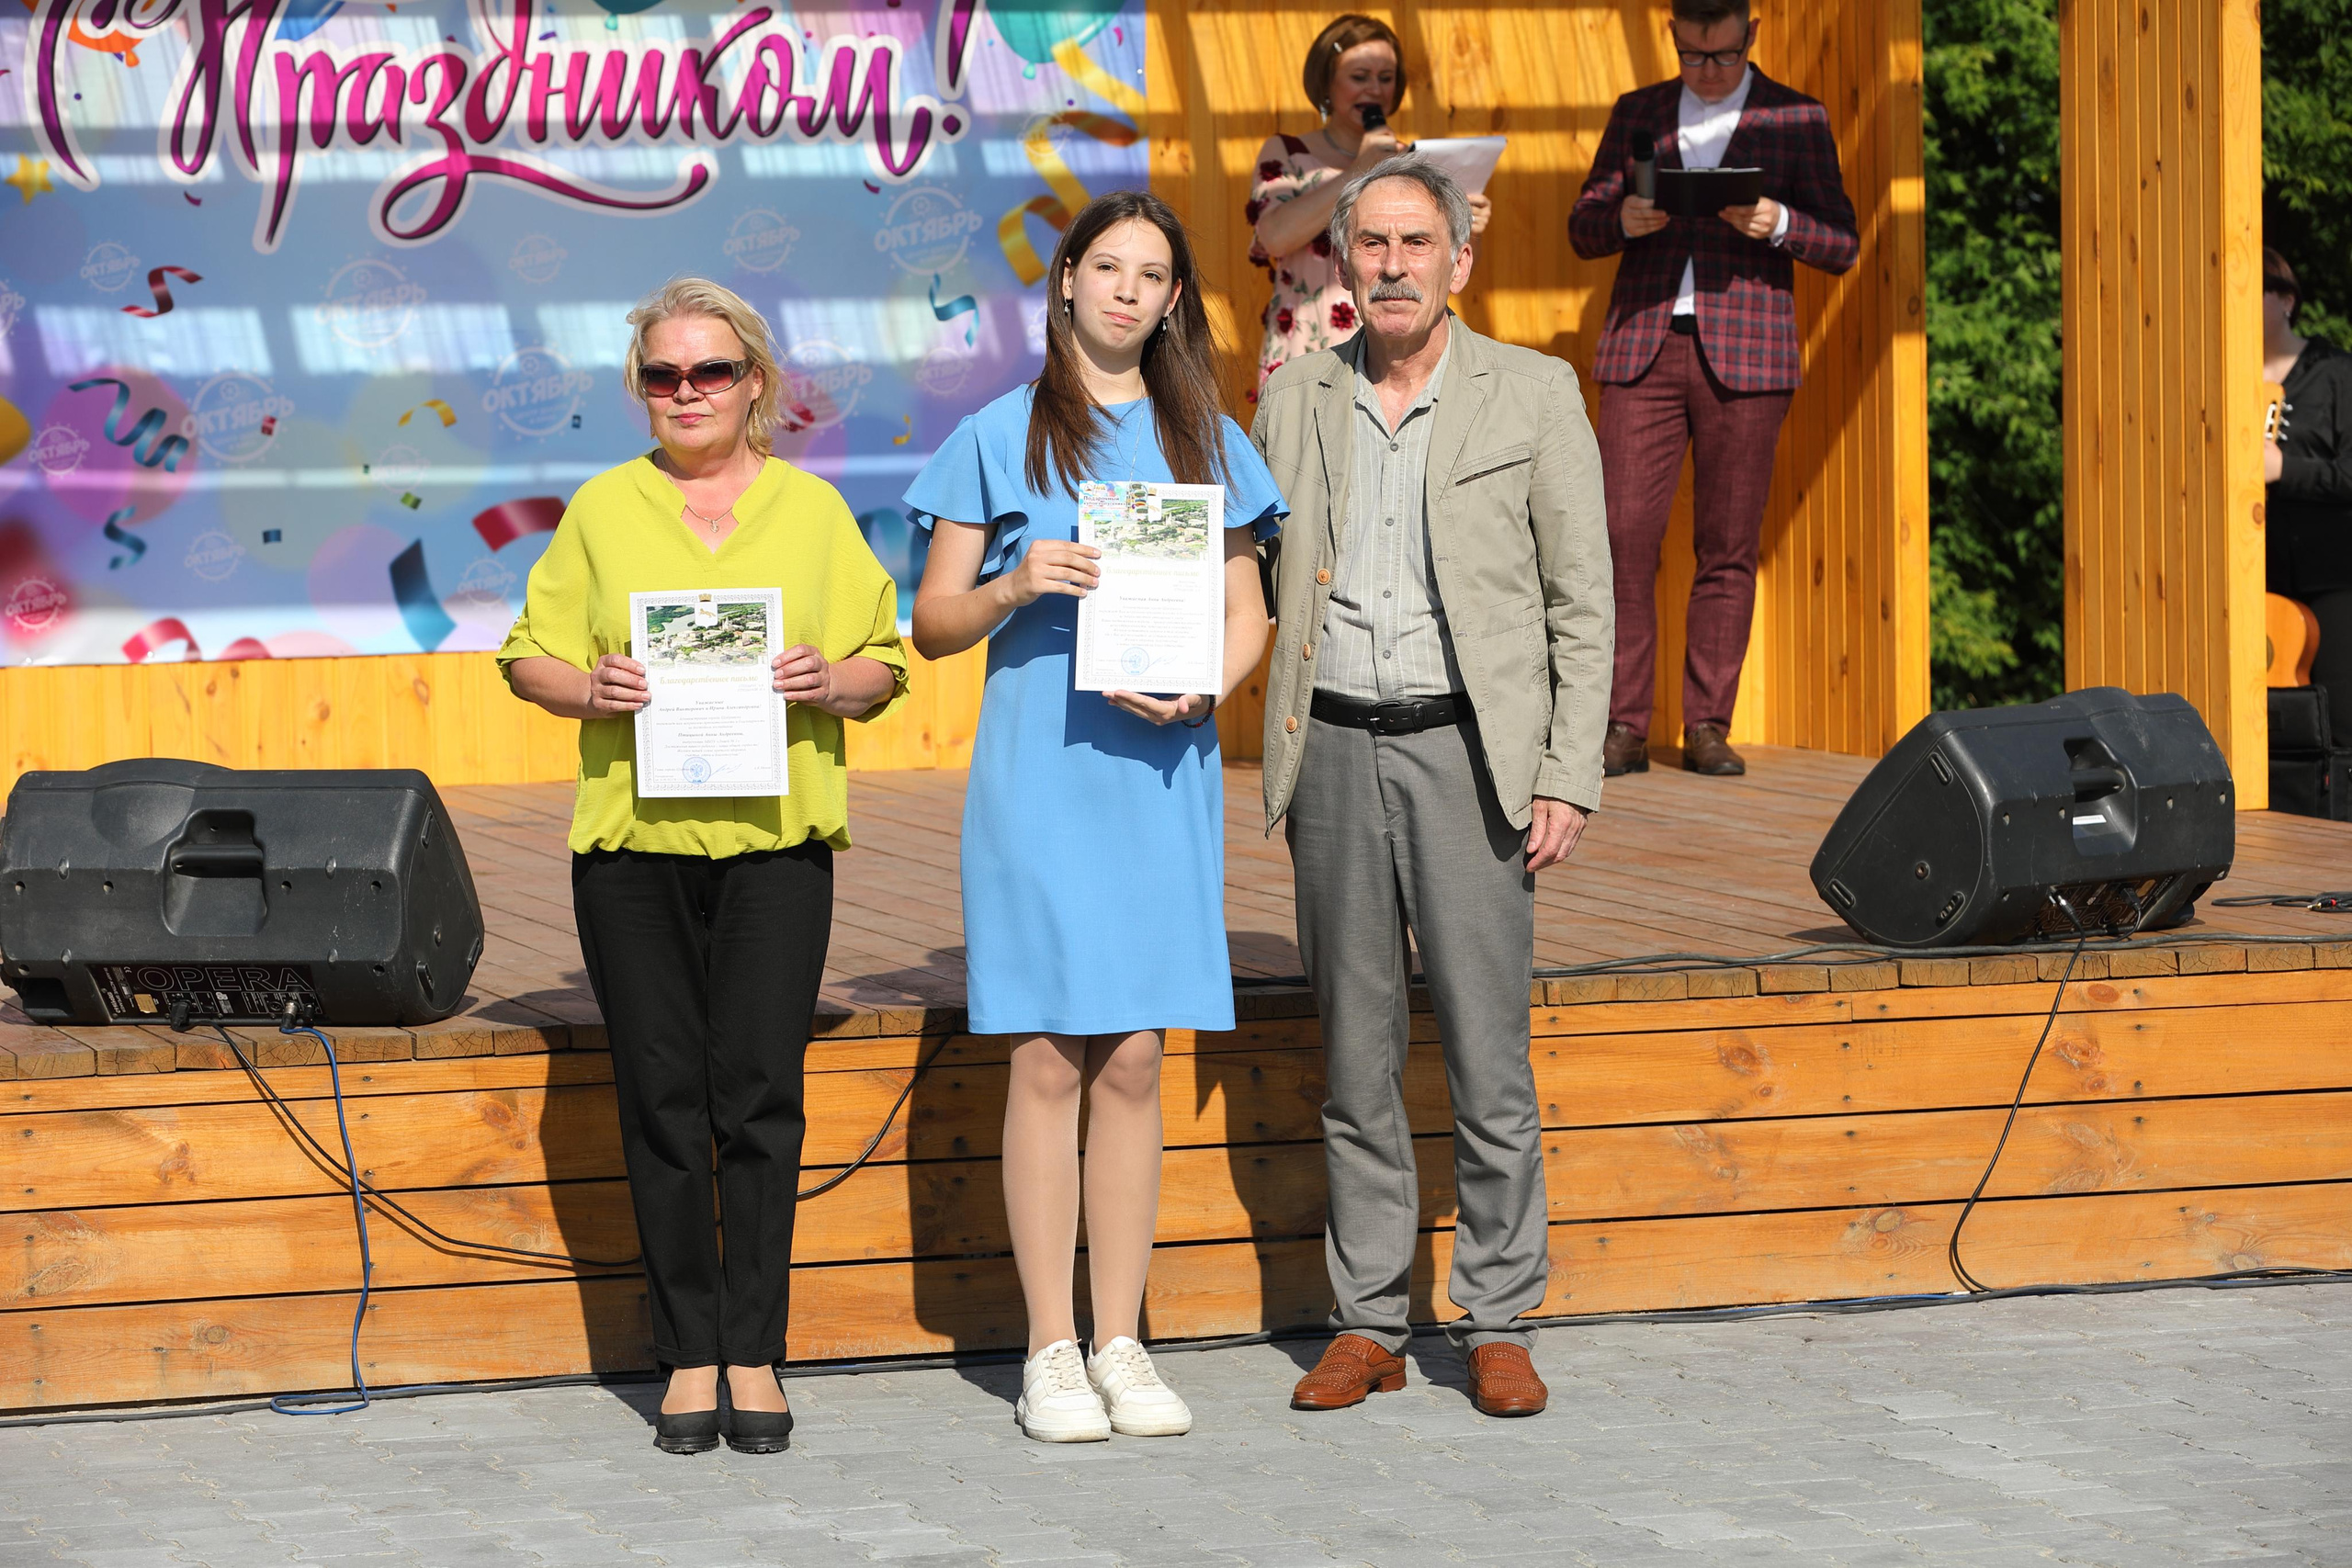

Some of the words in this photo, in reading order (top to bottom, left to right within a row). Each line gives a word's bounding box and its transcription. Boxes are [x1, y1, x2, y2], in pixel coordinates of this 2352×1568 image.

[723, 225, 801, 255] ОКТЯБРЬ
[873, 209, 983, 253] ОКТЯБРЬ
[80, 255, 141, 279] ОКТЯБРЬ
[315, 280, 428, 324] ОКТЯБРЬ
[482, 369, 594, 412] ОКТЯБРЬ
[792, 362, 873, 399] ТЯБРЬ
[180, 395, 295, 438] ОКТЯБРЬ
[28, 438, 90, 463] ОКТЯБРЬ
[184, 545, 246, 569] ОКТЯБРЬ
[458, 571, 517, 594] ОКТЯБРЬ
[1105, 566, 1172, 577] Благодарственное
[1173, 569, 1200, 577] письмо
[5, 592, 67, 617] ОКТЯБРЬ
[659, 674, 729, 686] Благодарственное
[137, 966, 313, 992] OPERA
